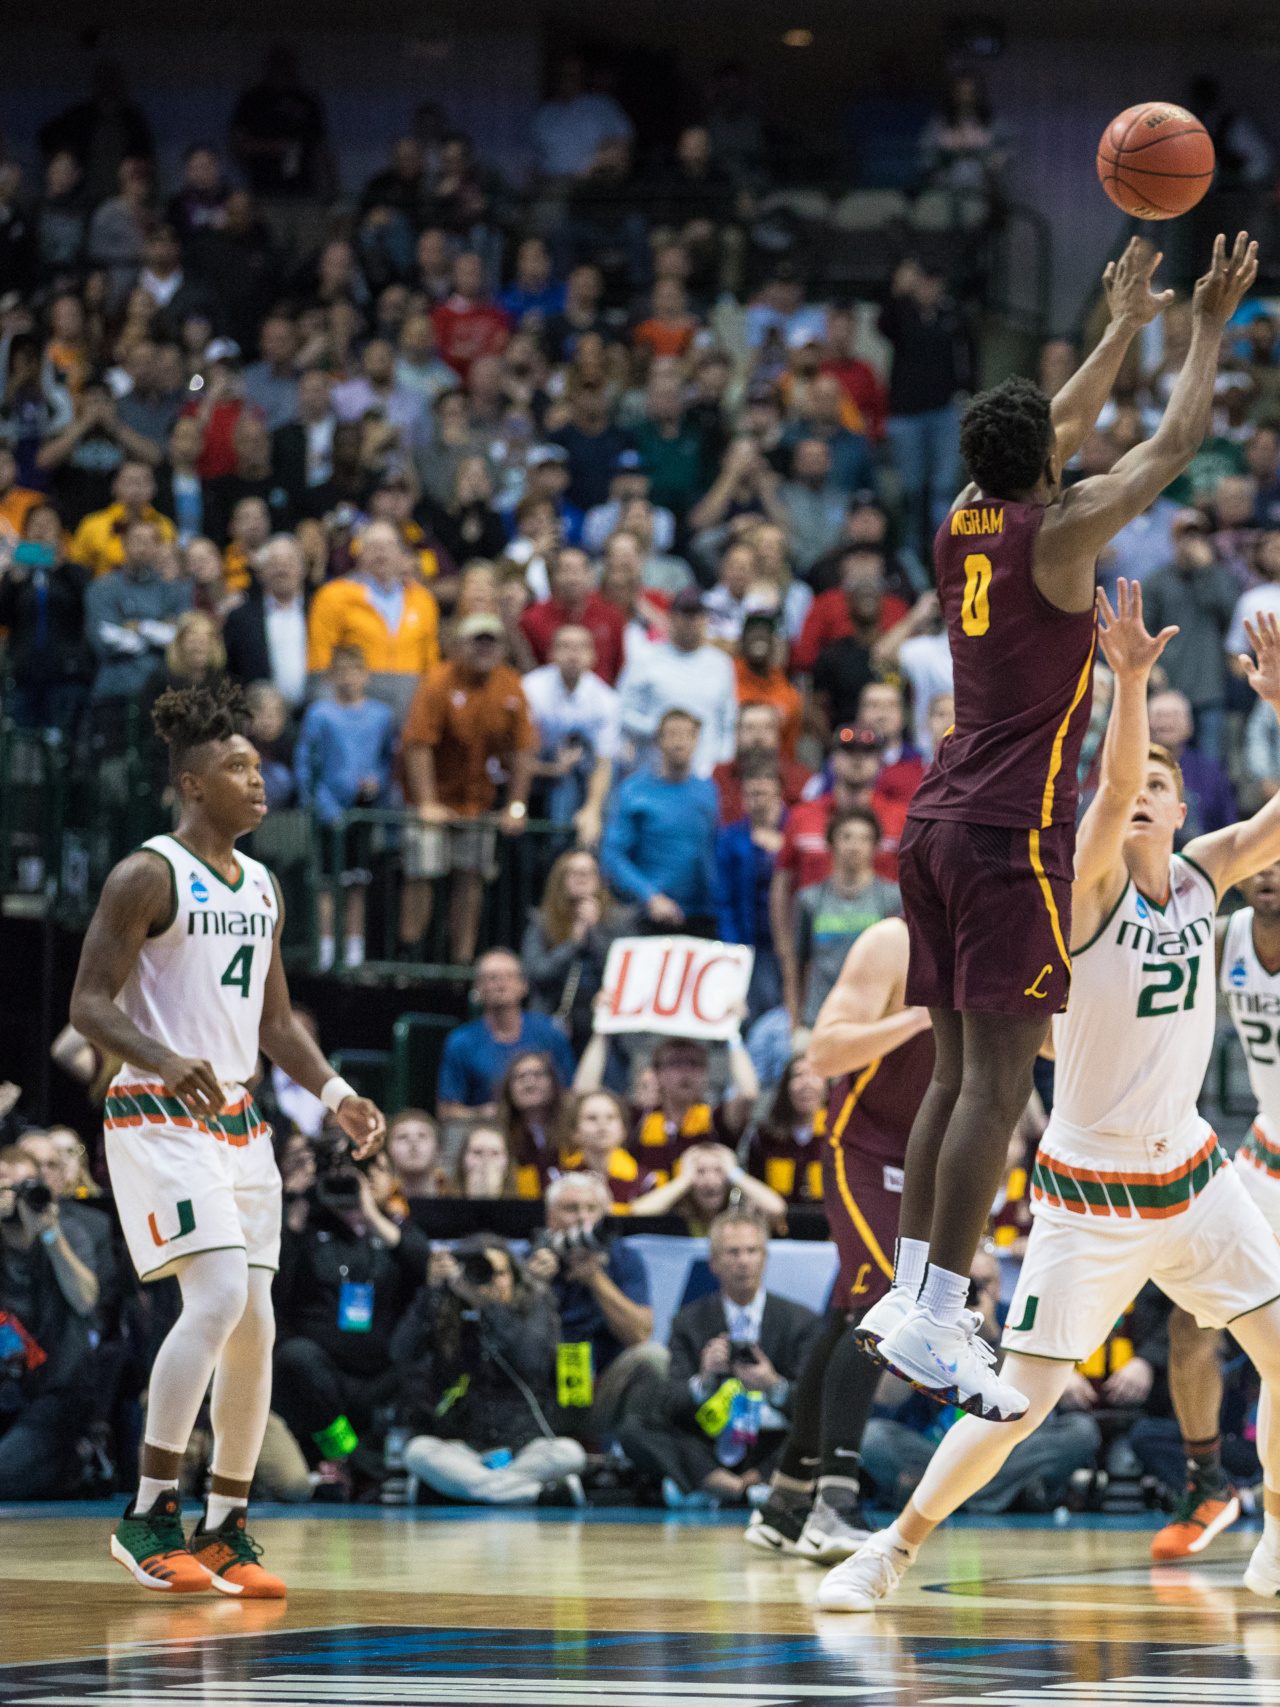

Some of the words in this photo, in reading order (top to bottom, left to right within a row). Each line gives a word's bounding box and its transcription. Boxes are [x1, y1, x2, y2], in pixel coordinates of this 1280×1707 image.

[961, 553, 992, 637] 0
[187, 910, 274, 937] miam
[1116, 911, 1213, 956] mam
[220, 944, 255, 998] 4
[611, 949, 742, 1024] LUC
[1024, 963, 1053, 999] L
[1136, 955, 1200, 1018] 21
[147, 1198, 196, 1247] U
[850, 1263, 873, 1296] L
